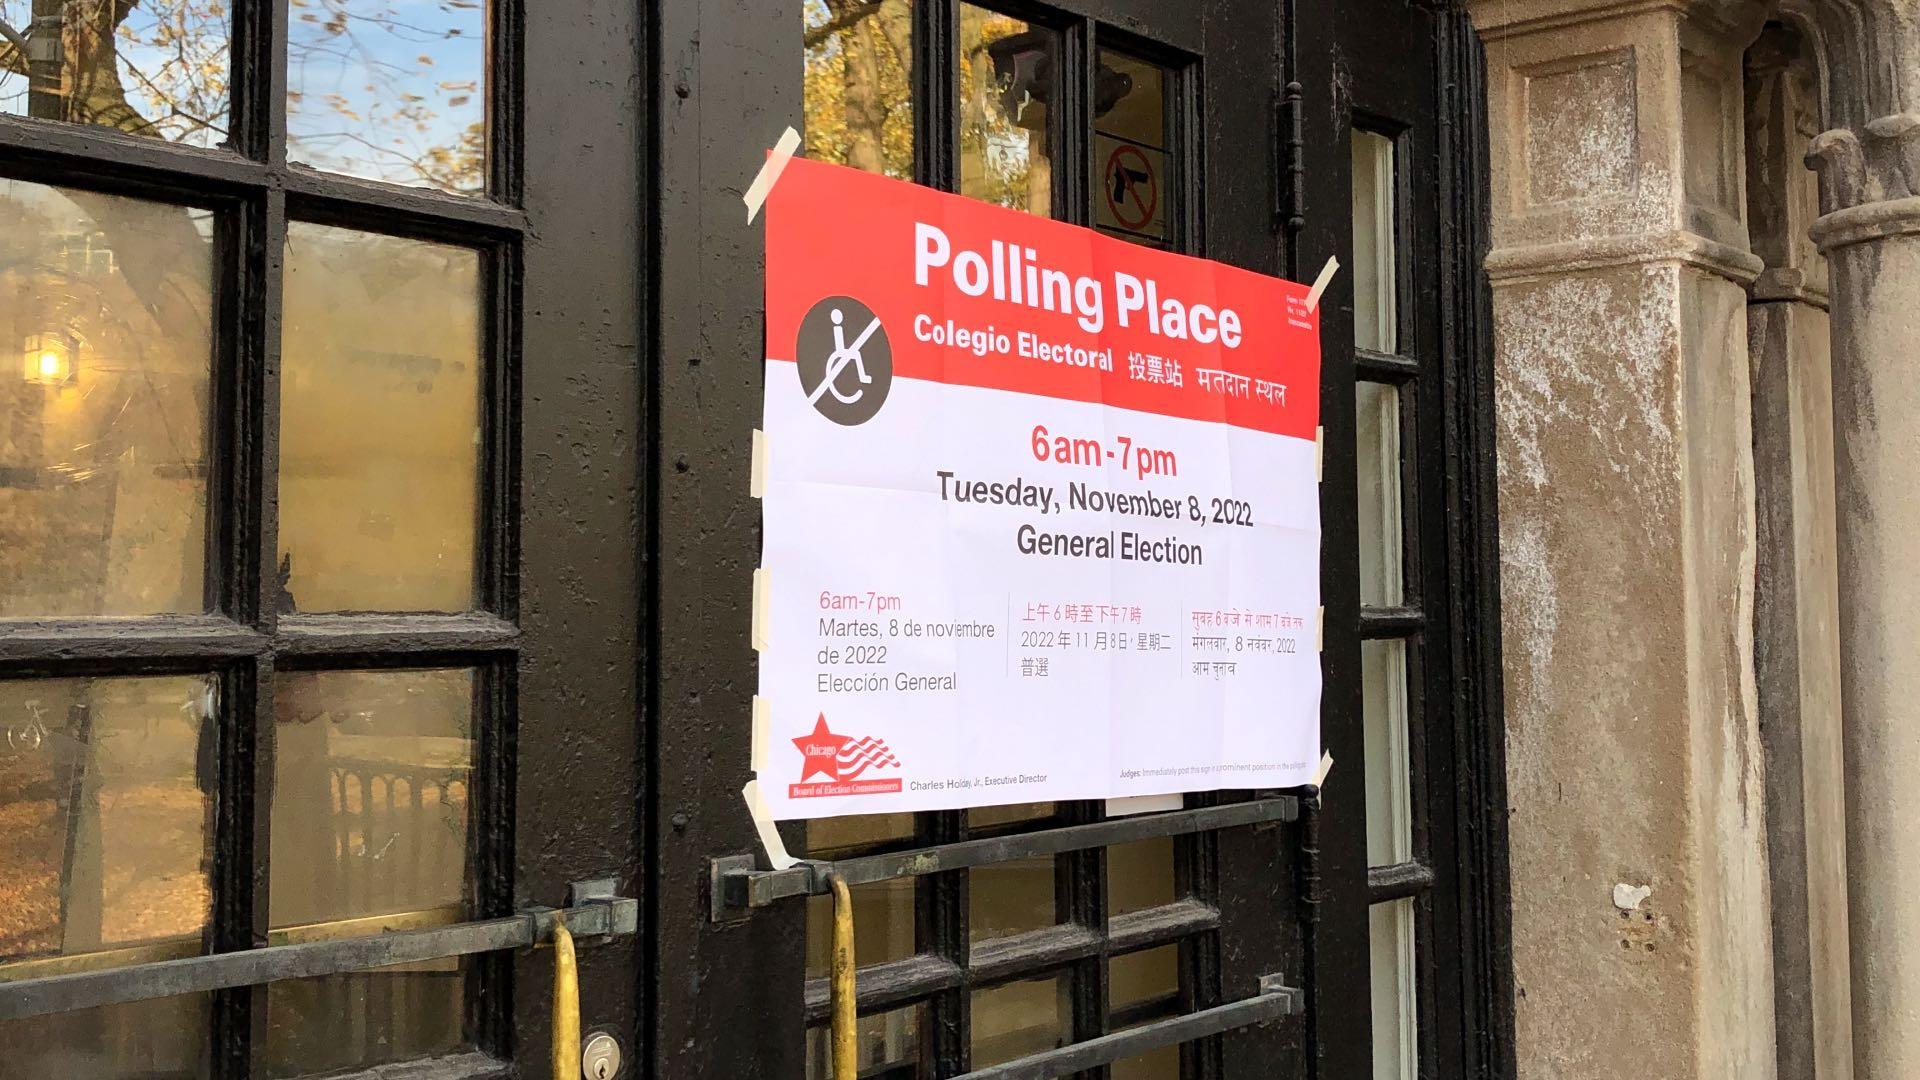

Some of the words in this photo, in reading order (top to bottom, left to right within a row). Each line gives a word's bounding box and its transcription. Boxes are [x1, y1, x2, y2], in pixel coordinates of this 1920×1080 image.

[915, 222, 1104, 333] Polling
[1115, 271, 1242, 349] Place
[914, 313, 1010, 357] Colegio
[1017, 331, 1113, 372] Electoral
[1128, 351, 1183, 388] 投票站
[1196, 368, 1251, 400] मतदान
[1255, 379, 1287, 407] स्थल
[937, 470, 1060, 514] Tuesday,
[1069, 482, 1182, 519] November
[1188, 495, 1206, 527] 8,
[1212, 497, 1254, 527] 2022
[1017, 524, 1114, 559] General
[1121, 531, 1202, 565] Election
[819, 591, 901, 614] 6am-7pm
[819, 618, 883, 639] Martes,
[889, 618, 899, 637] 8
[904, 618, 922, 637] de
[926, 619, 995, 638] noviembre
[1215, 611, 1222, 626] 6
[1235, 635, 1243, 652] 8
[1277, 638, 1295, 653] 2022
[817, 646, 839, 664] de
[845, 646, 887, 664] 2022
[1021, 657, 1049, 677] 普選
[817, 673, 889, 692] Elección
[895, 672, 956, 690] General
[806, 743, 837, 759] Chicago
[793, 785, 815, 796] Board
[816, 785, 823, 795] of
[824, 785, 850, 795] Election
[910, 781, 944, 791] Charles
[985, 775, 1017, 786] Executive
[1019, 774, 1047, 784] Director
